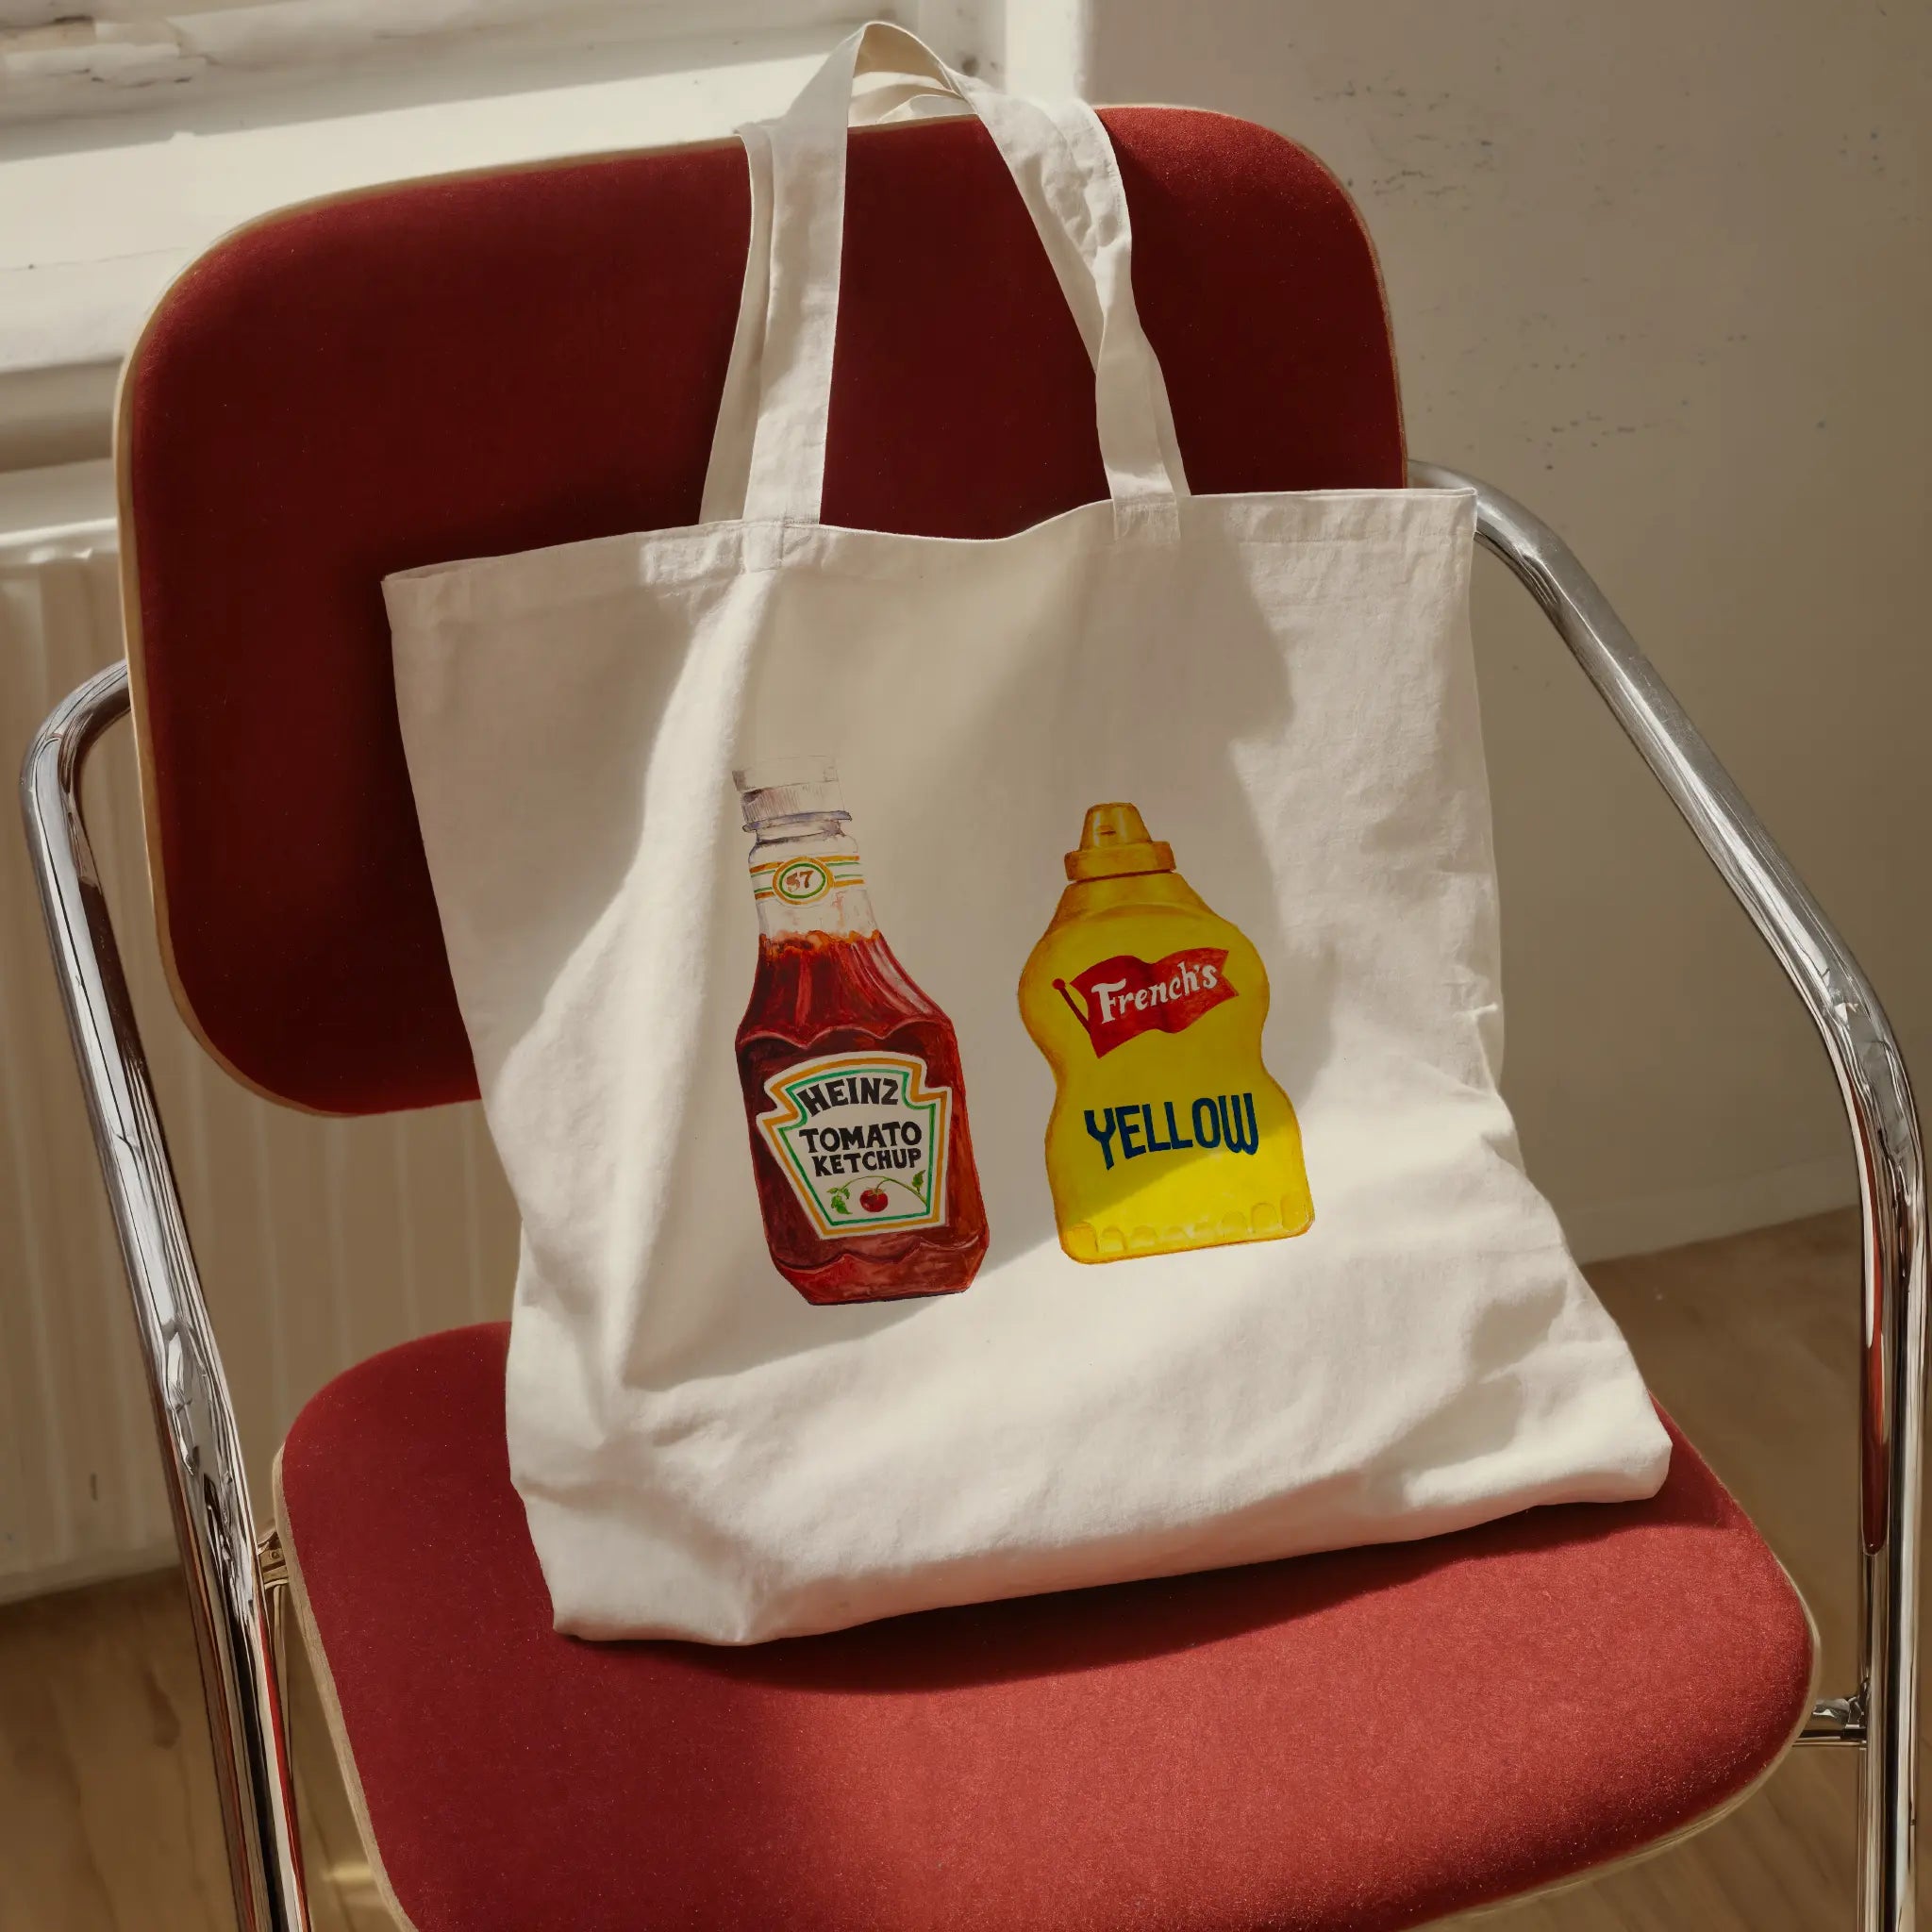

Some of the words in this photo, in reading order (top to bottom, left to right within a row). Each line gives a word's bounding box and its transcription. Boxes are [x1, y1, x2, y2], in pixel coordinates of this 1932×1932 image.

[1091, 959, 1218, 1024] French's
[796, 1076, 899, 1117] HEINZ
[799, 1121, 923, 1153] TOMATO
[1084, 1092, 1259, 1171] YELLOW
[811, 1148, 922, 1176] KETCHUP
